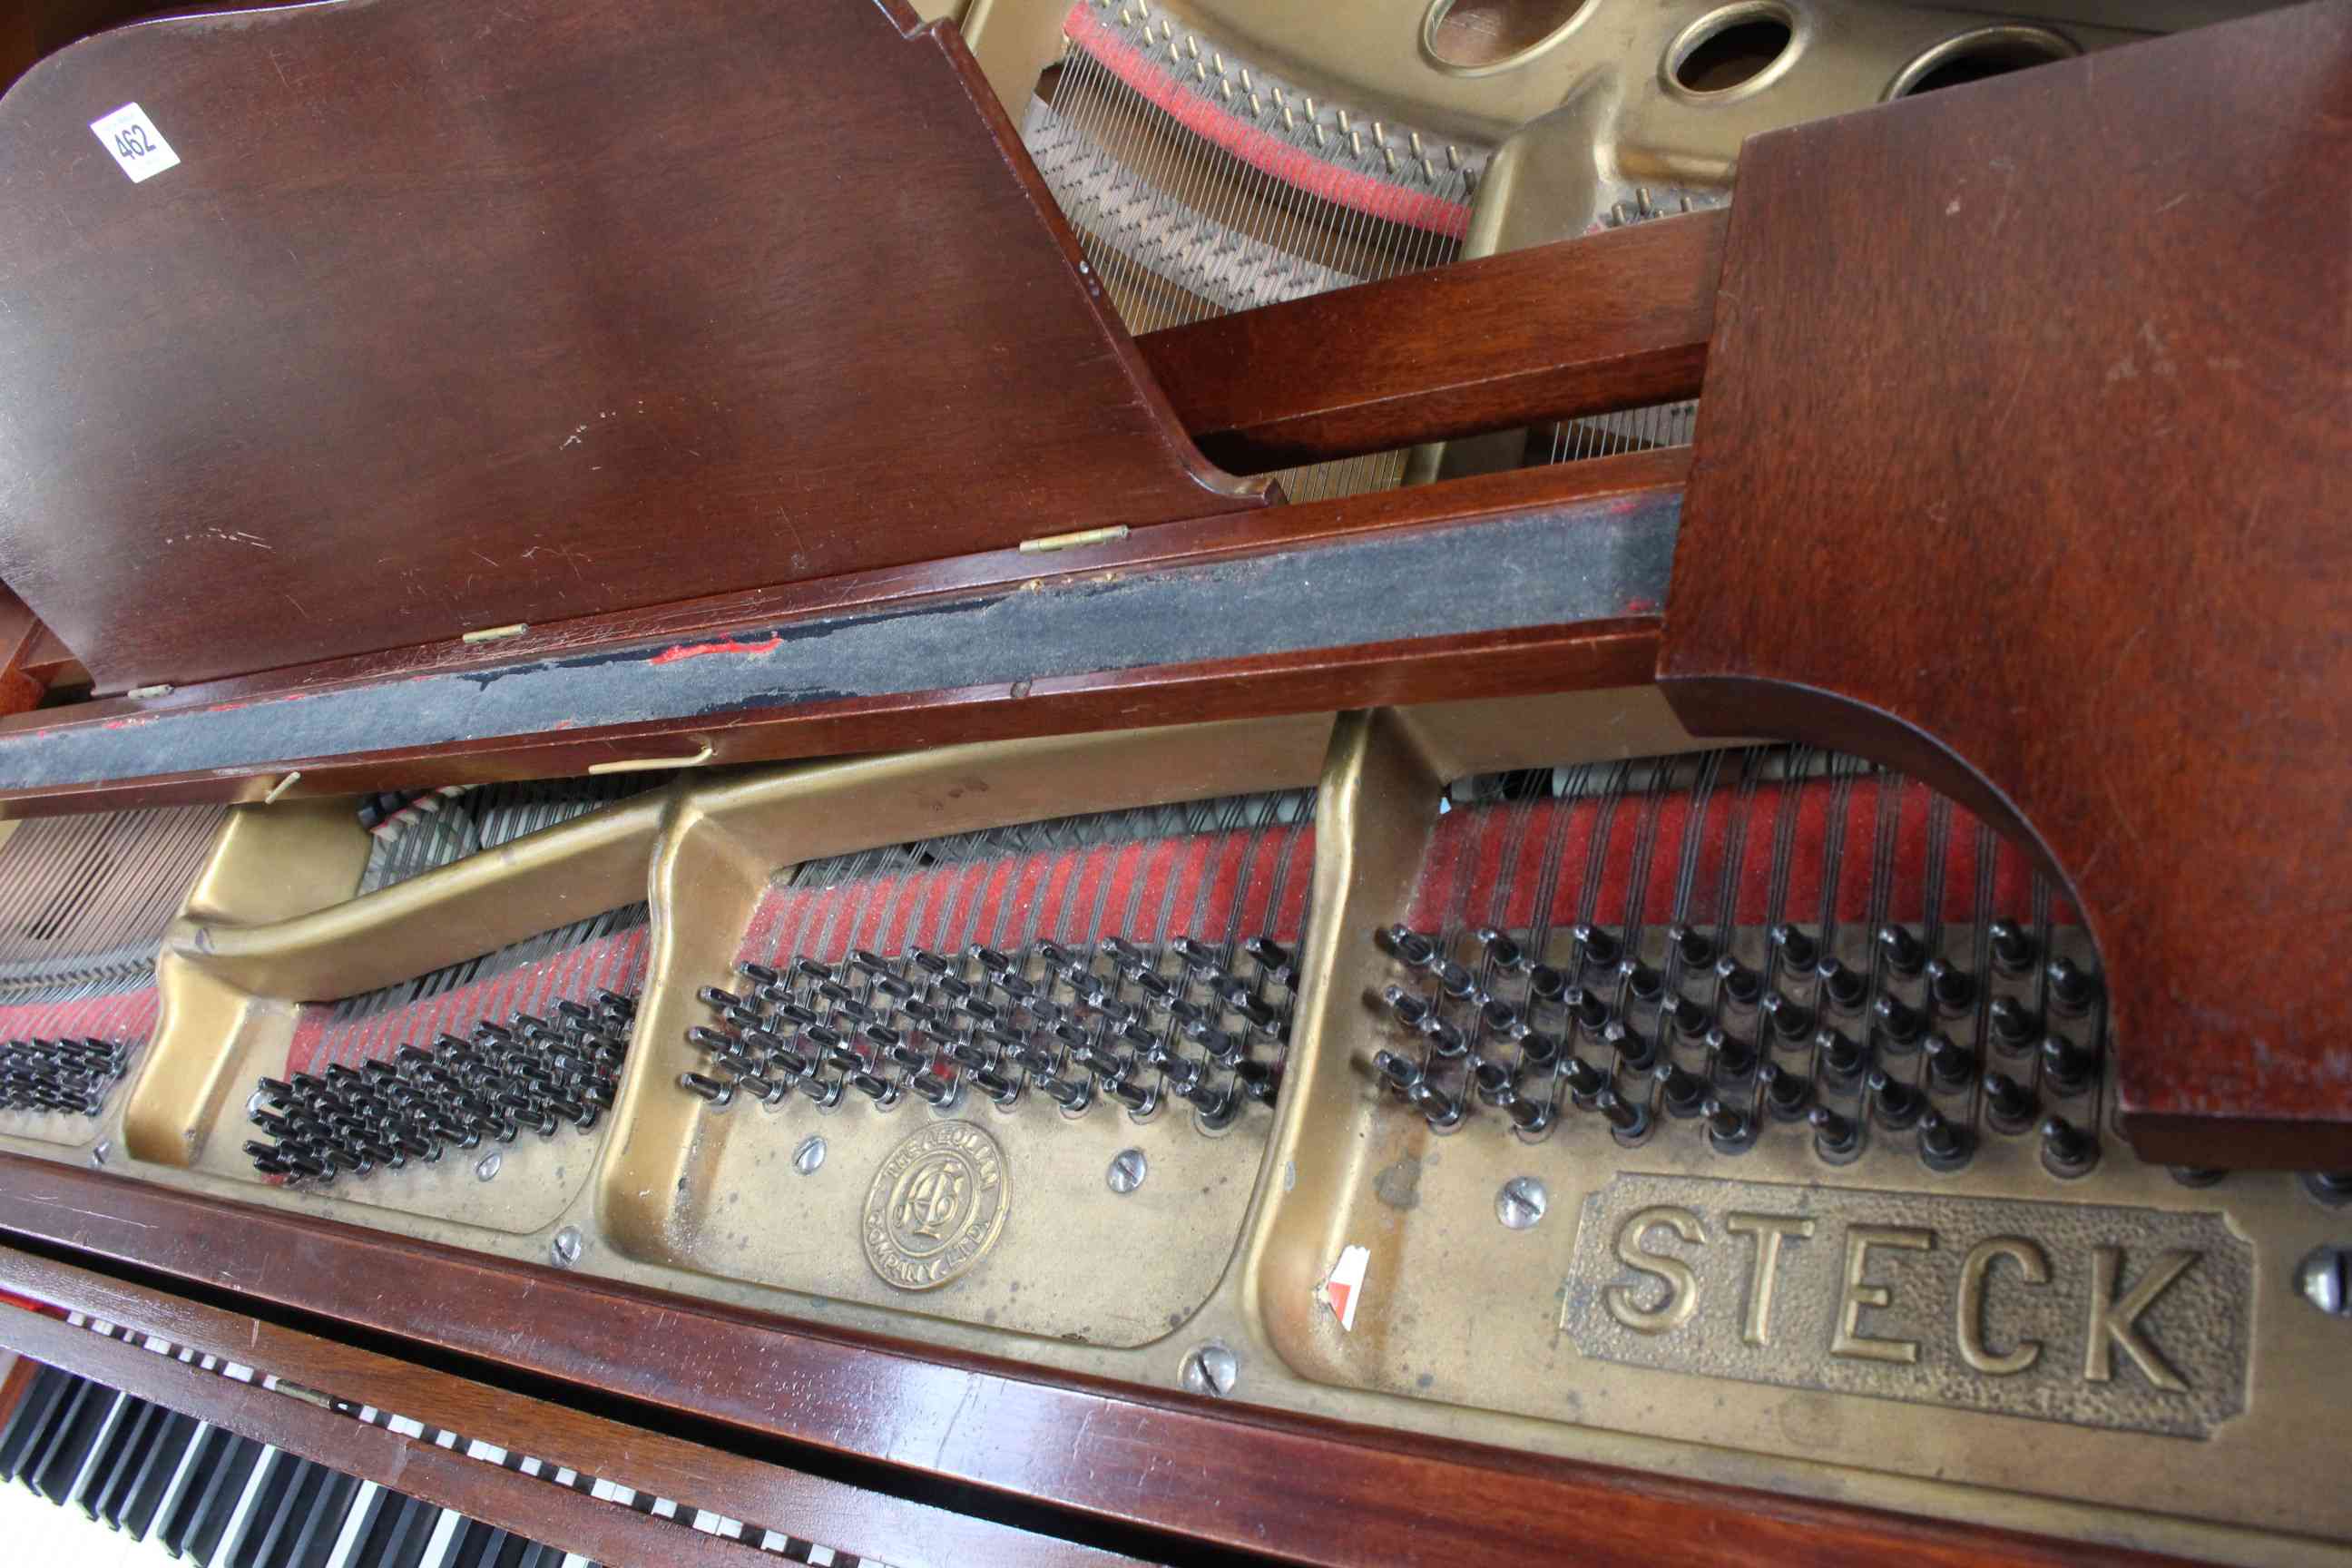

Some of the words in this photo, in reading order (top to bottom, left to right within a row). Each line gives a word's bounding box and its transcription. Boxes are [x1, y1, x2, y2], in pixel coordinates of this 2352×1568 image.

[114, 124, 156, 160] 462
[884, 1140, 923, 1178] THE
[923, 1130, 998, 1191] AEOLIAN
[1603, 1204, 2203, 1393] STECK
